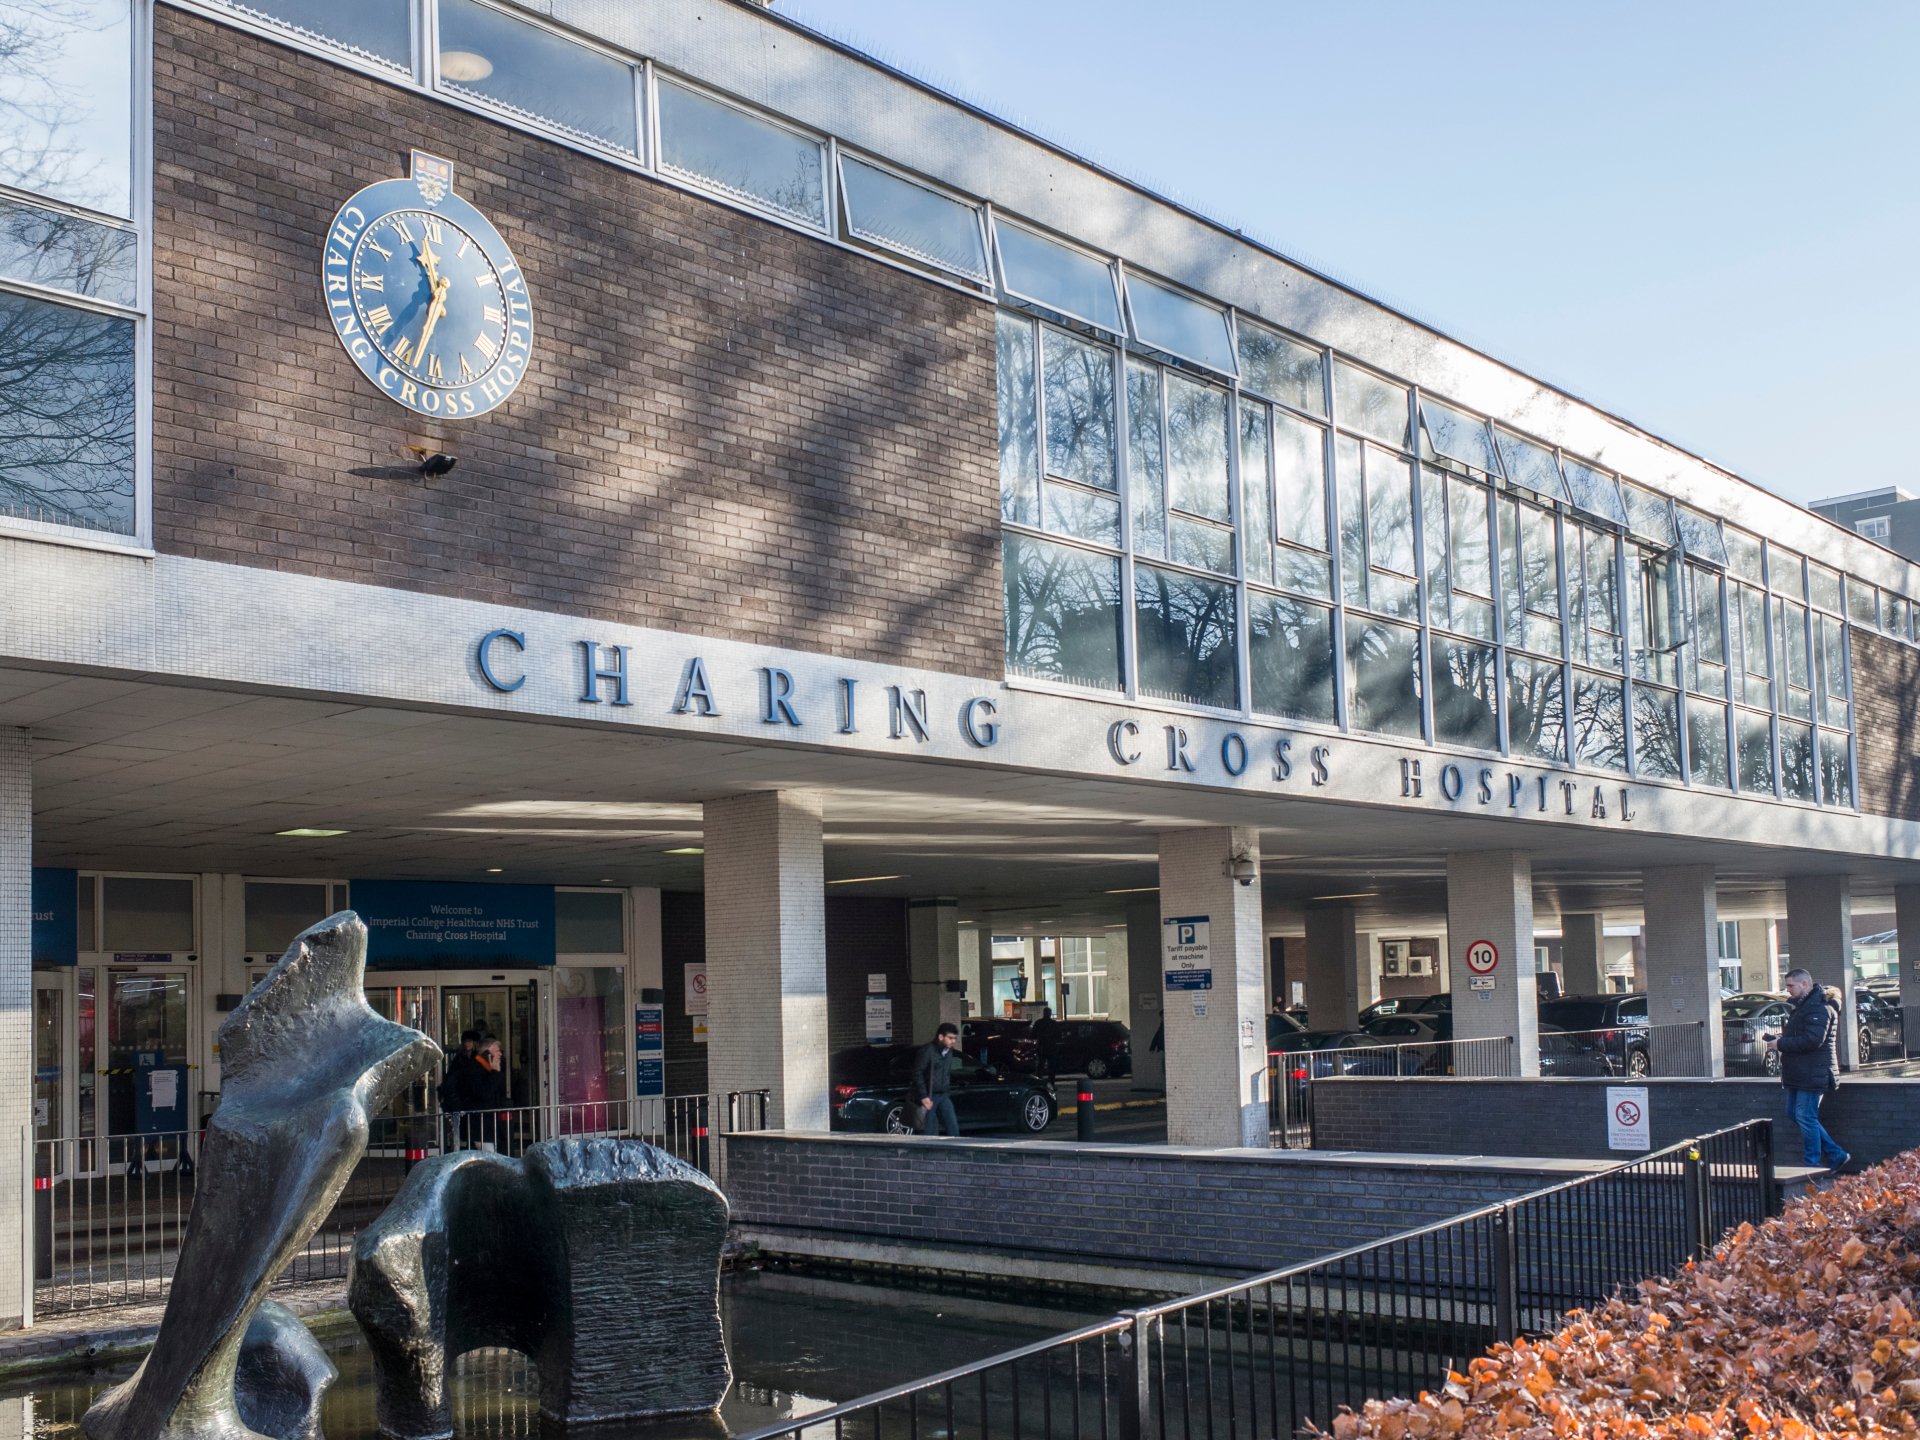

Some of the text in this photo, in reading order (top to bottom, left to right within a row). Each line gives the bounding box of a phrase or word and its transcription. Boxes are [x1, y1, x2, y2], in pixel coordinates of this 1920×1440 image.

[390, 220, 415, 245] XI
[421, 219, 444, 245] XII
[368, 238, 392, 262] X
[456, 237, 470, 260] I
[361, 270, 384, 293] IX
[475, 273, 494, 288] II
[327, 206, 530, 415] CHARING CROSS HOSPITAL
[367, 304, 394, 336] VIII
[483, 304, 501, 325] III
[392, 335, 415, 366] VII
[427, 353, 443, 379] VI
[459, 352, 473, 377] V
[478, 628, 1636, 822] CHARING CROSS HOSPITAL
[31, 909, 55, 921] rust
[430, 904, 483, 915] Welcome to
[369, 916, 539, 929] Imperial College Healthcare NHS Trust
[406, 929, 507, 942] Charing Cross Hospital
[1184, 944, 1208, 953] payable
[1473, 949, 1492, 964] 10
[1181, 962, 1195, 970] Only
